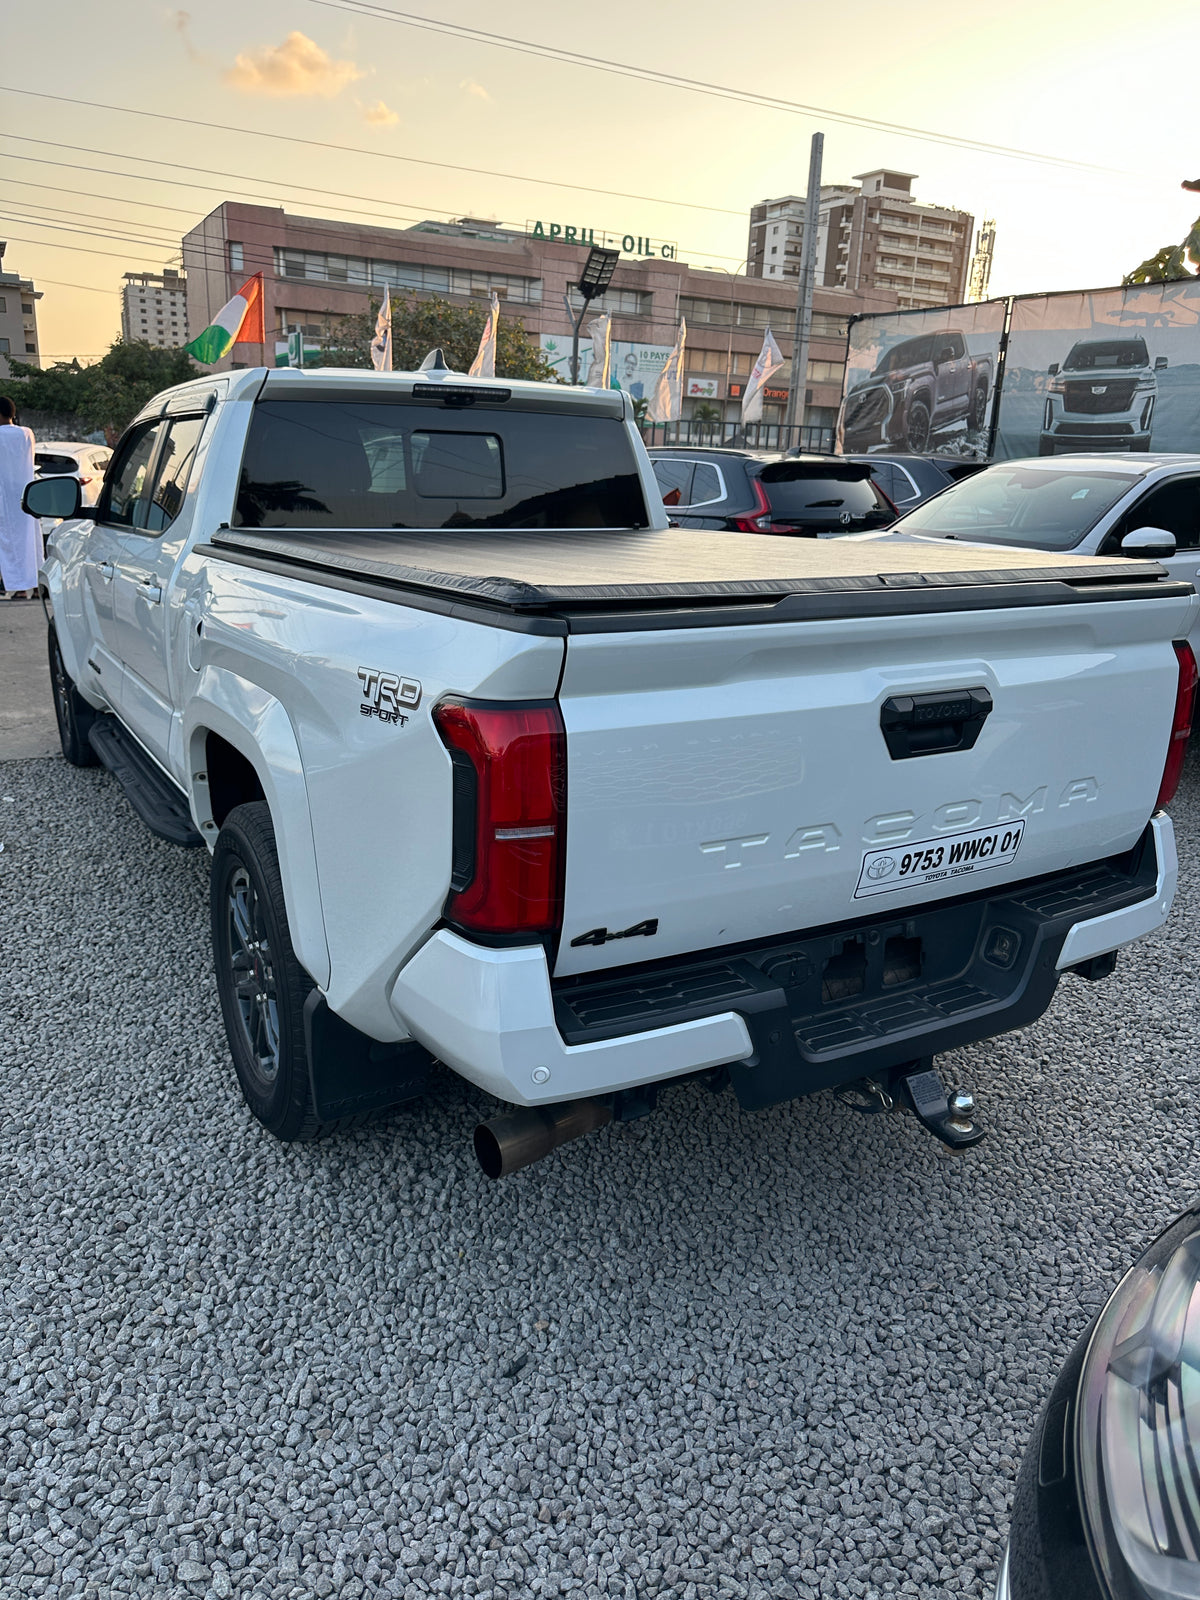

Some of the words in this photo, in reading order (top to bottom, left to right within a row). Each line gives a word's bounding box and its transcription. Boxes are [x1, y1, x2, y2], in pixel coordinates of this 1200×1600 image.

[532, 221, 599, 248] APRIL
[622, 235, 655, 256] OIL
[661, 245, 674, 259] CI
[650, 352, 670, 360] PAYS
[357, 666, 423, 711] TRD
[360, 704, 409, 728] SPORT
[917, 704, 968, 719] TOYOTA
[699, 776, 1101, 870] TACOMA
[899, 846, 945, 876] 9753
[949, 835, 999, 865] WWCI
[1001, 829, 1021, 852] 01
[925, 871, 948, 881] TOYOTA
[951, 865, 975, 876] TACOMA
